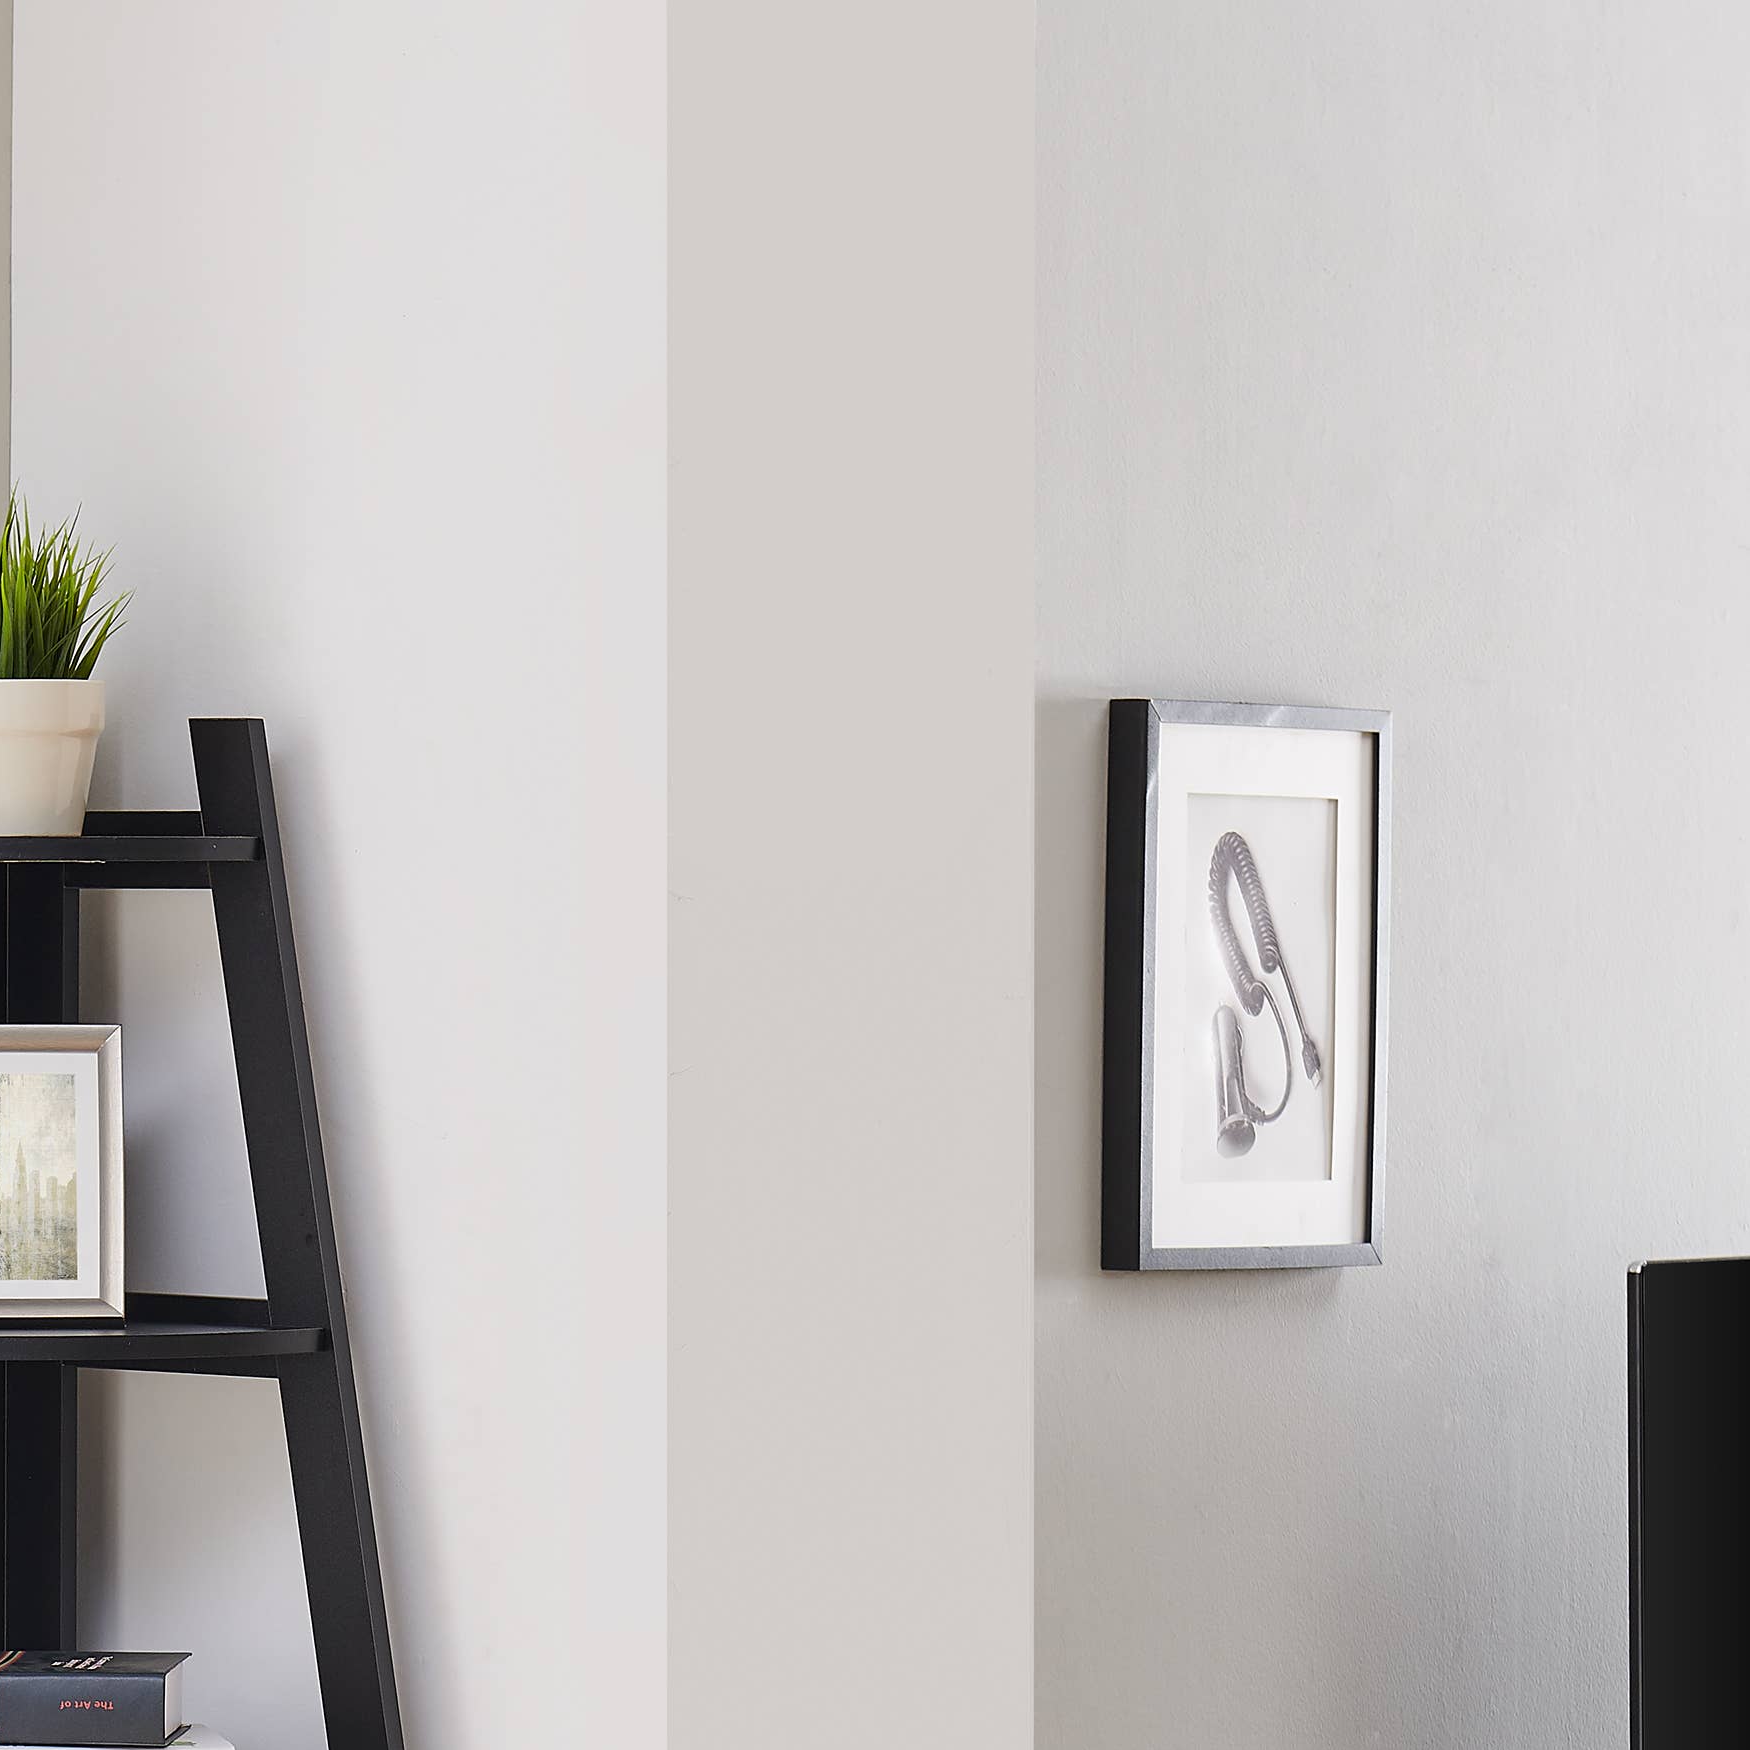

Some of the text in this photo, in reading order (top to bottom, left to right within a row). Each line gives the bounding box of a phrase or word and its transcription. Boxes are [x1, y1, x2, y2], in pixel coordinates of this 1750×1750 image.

[59, 1701, 114, 1710] The Art of
